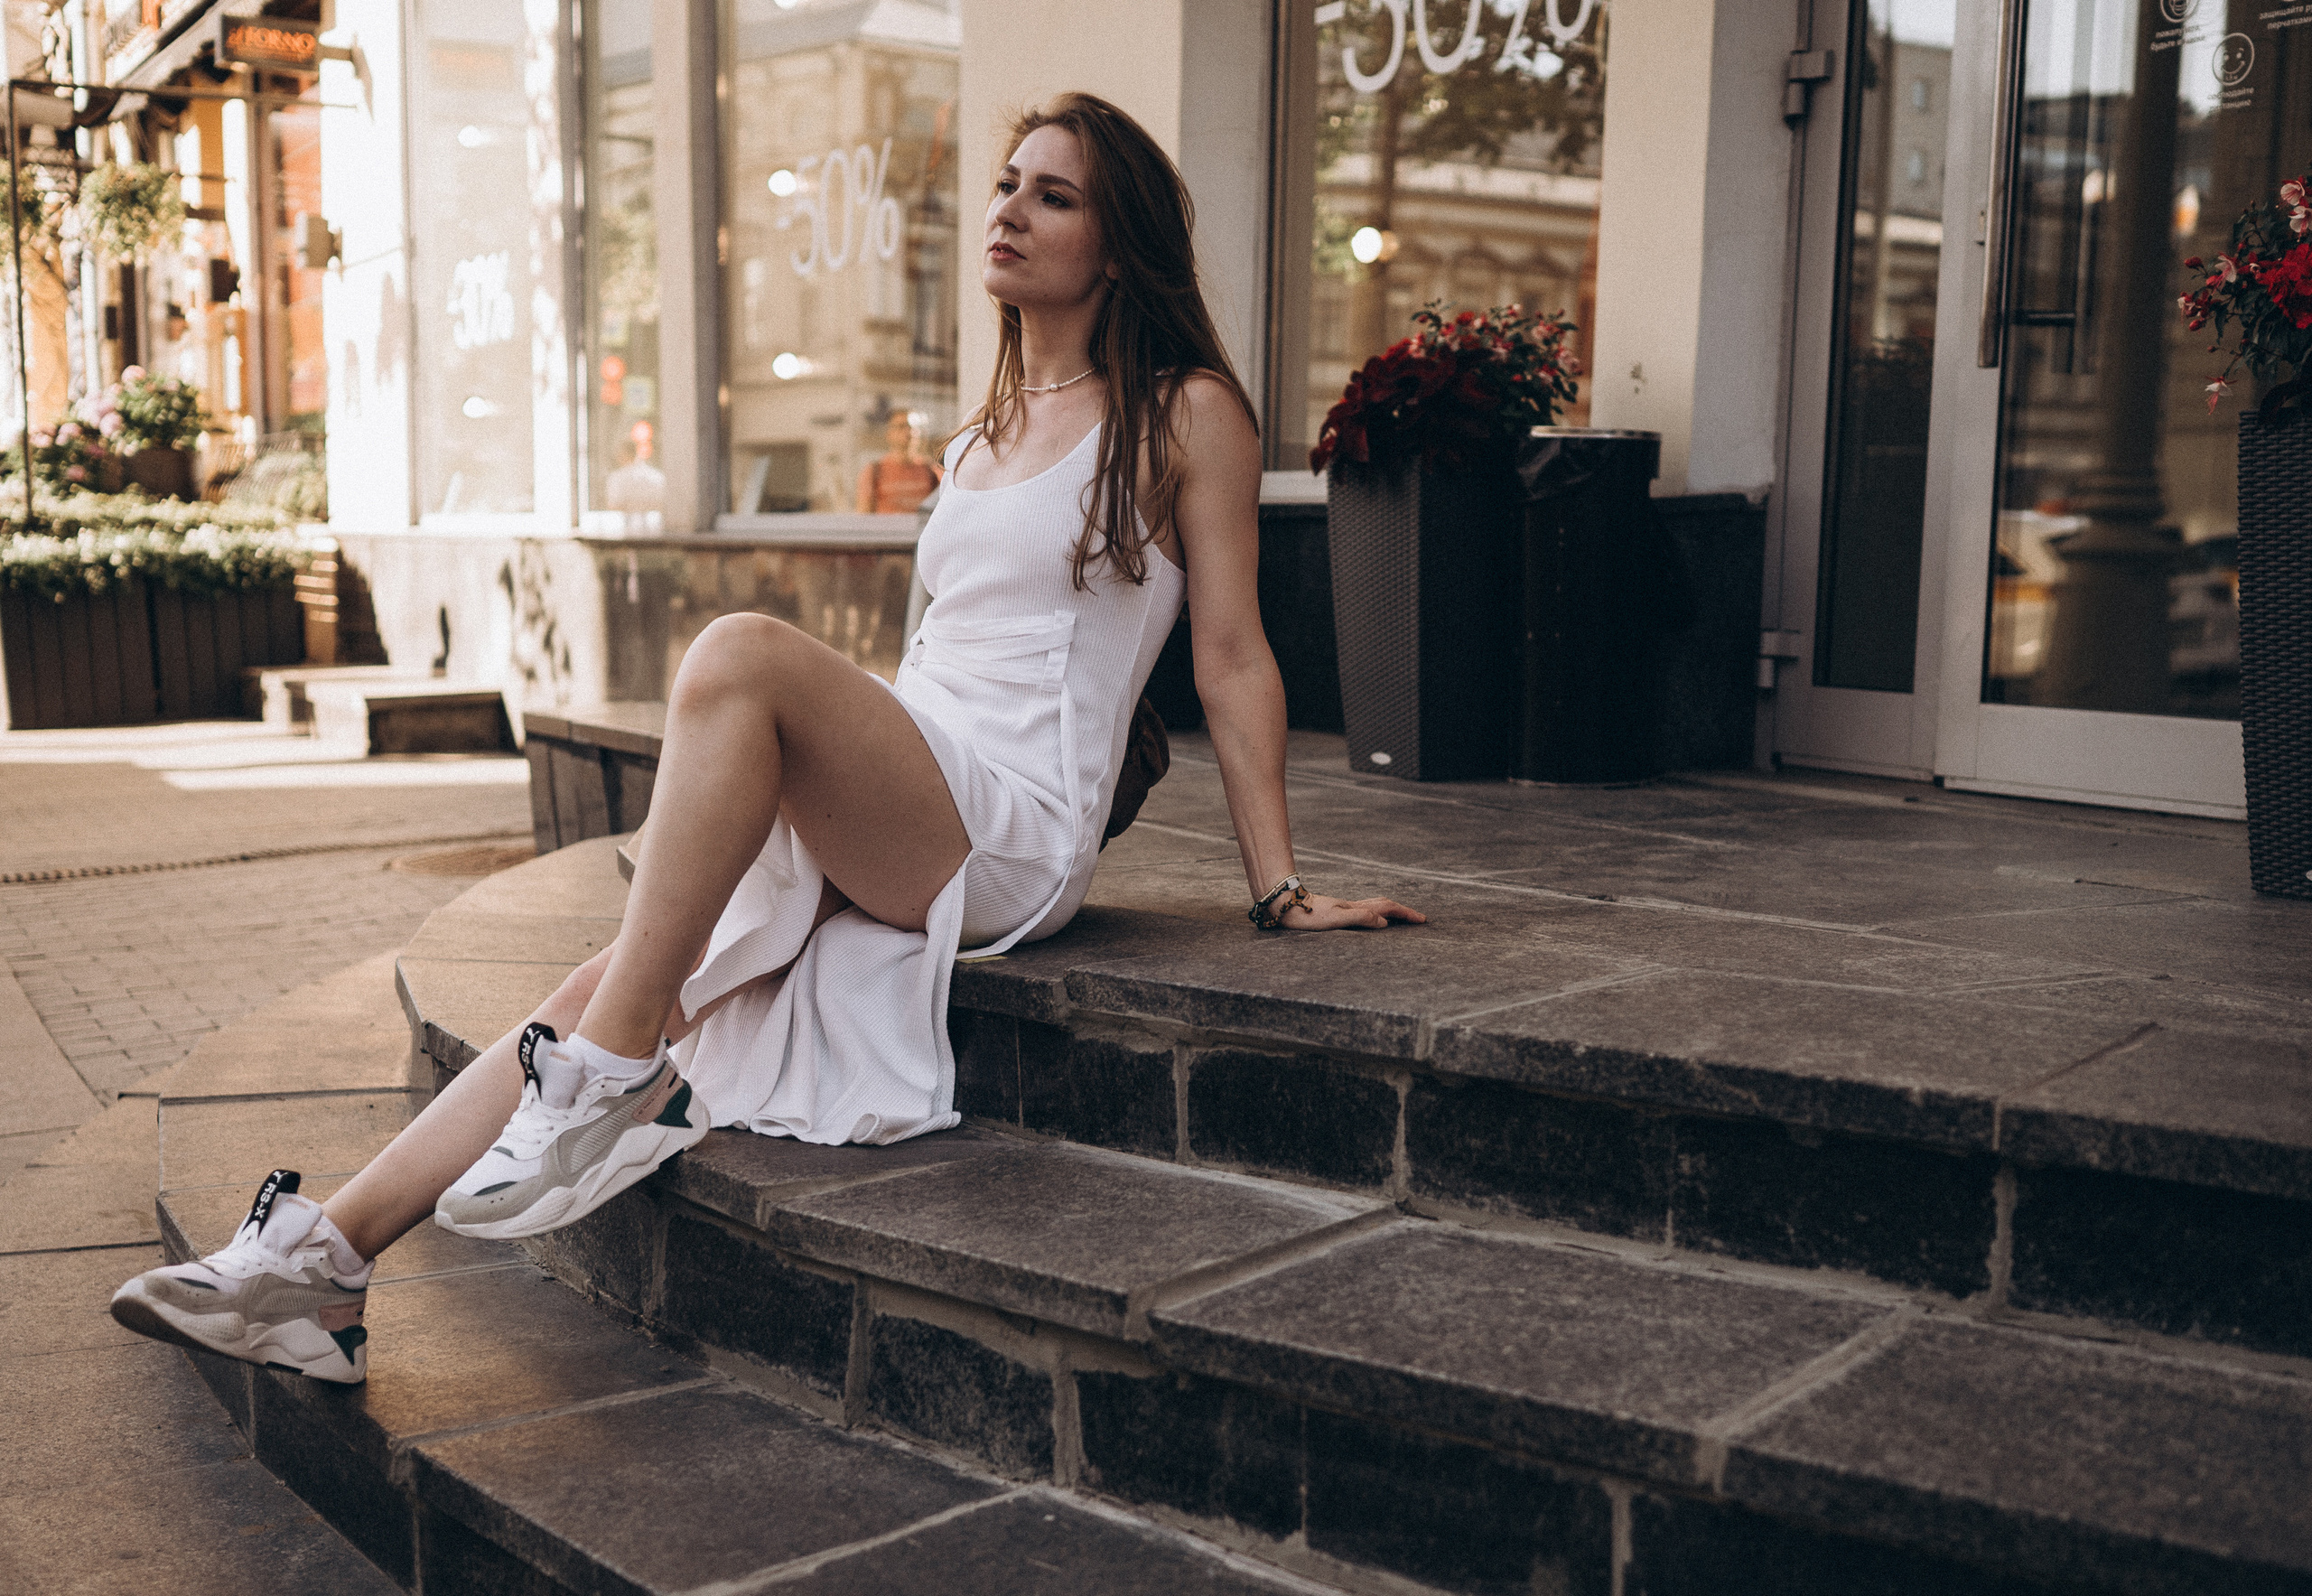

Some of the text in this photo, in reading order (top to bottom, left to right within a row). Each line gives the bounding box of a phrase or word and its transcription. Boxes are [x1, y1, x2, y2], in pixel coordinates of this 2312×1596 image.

[2259, 5, 2304, 19] защищайте
[775, 136, 901, 275] -50%
[255, 1182, 277, 1218] RS-X
